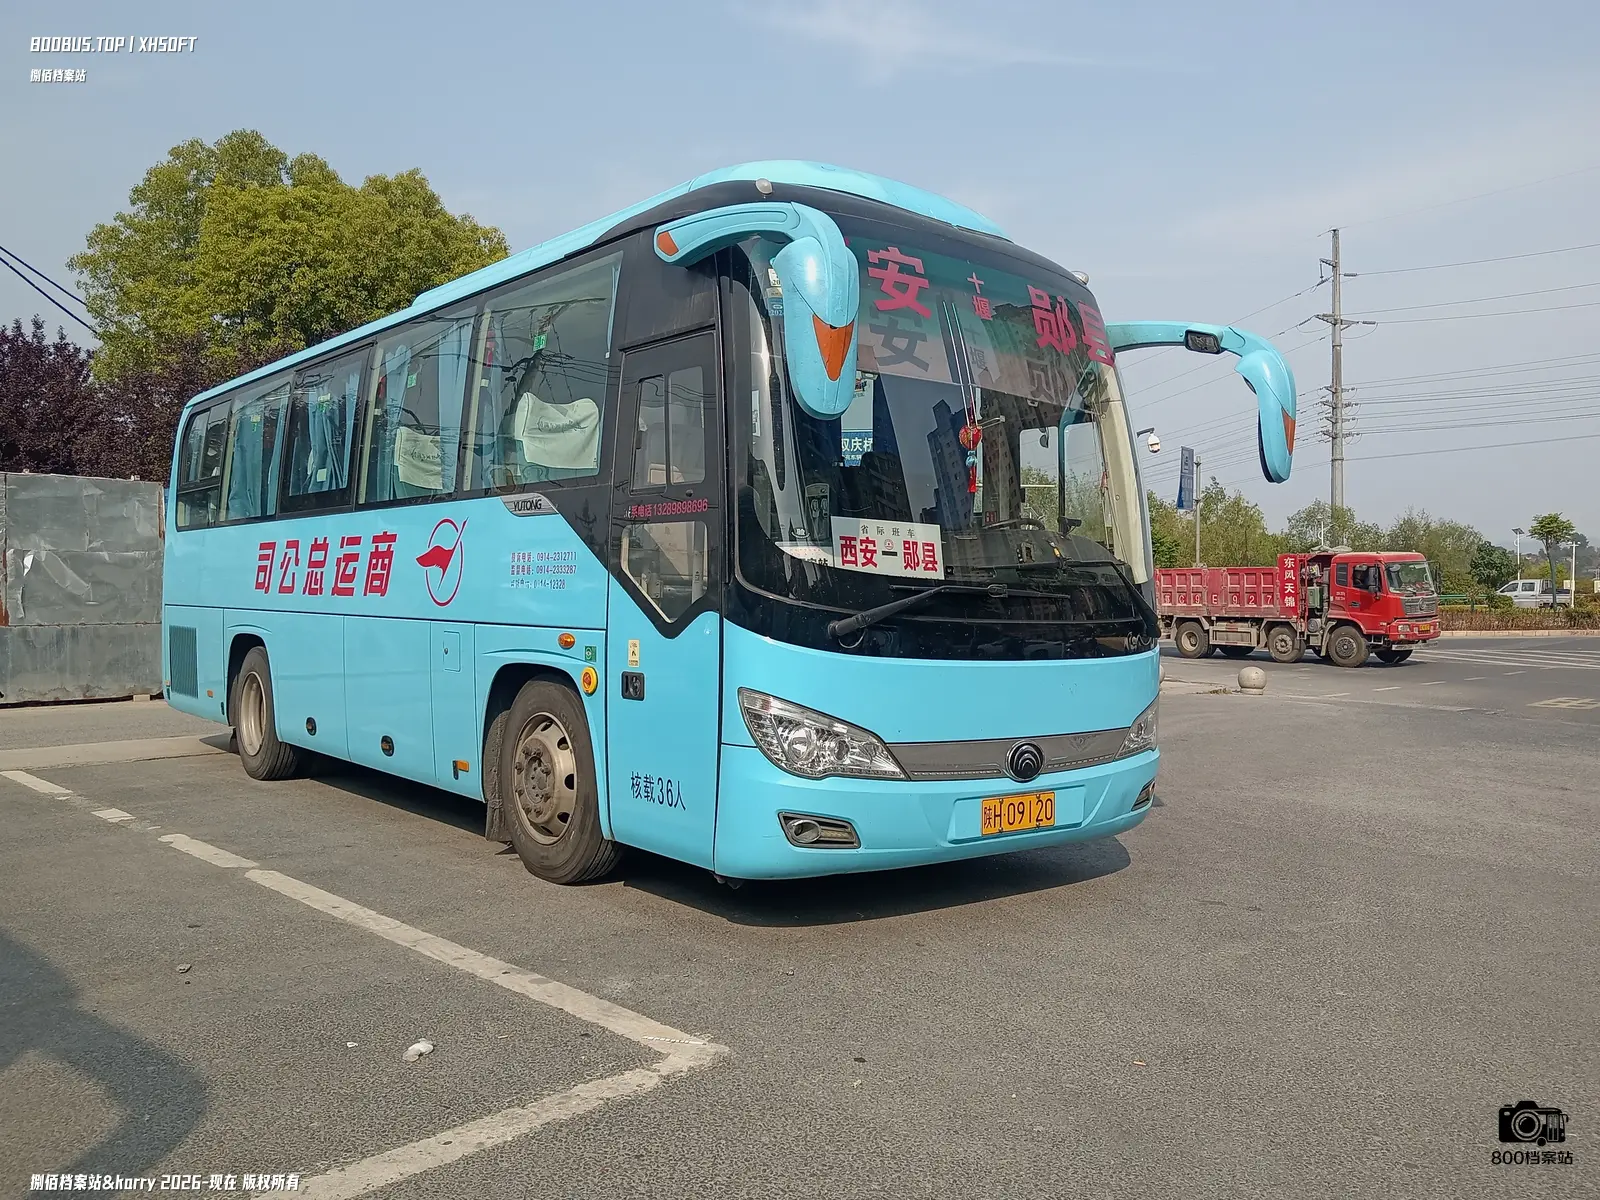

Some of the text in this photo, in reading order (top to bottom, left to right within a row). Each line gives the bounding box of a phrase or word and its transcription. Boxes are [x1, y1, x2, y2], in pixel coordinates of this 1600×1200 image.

[513, 497, 542, 511] YUTONG
[653, 498, 708, 516] 13289898696
[861, 524, 915, 539] 省际班车
[536, 551, 577, 562] 0914-2312711
[535, 564, 577, 575] 0914-2333287
[1283, 556, 1296, 608] 东风天锦
[630, 770, 687, 811] 核载36人
